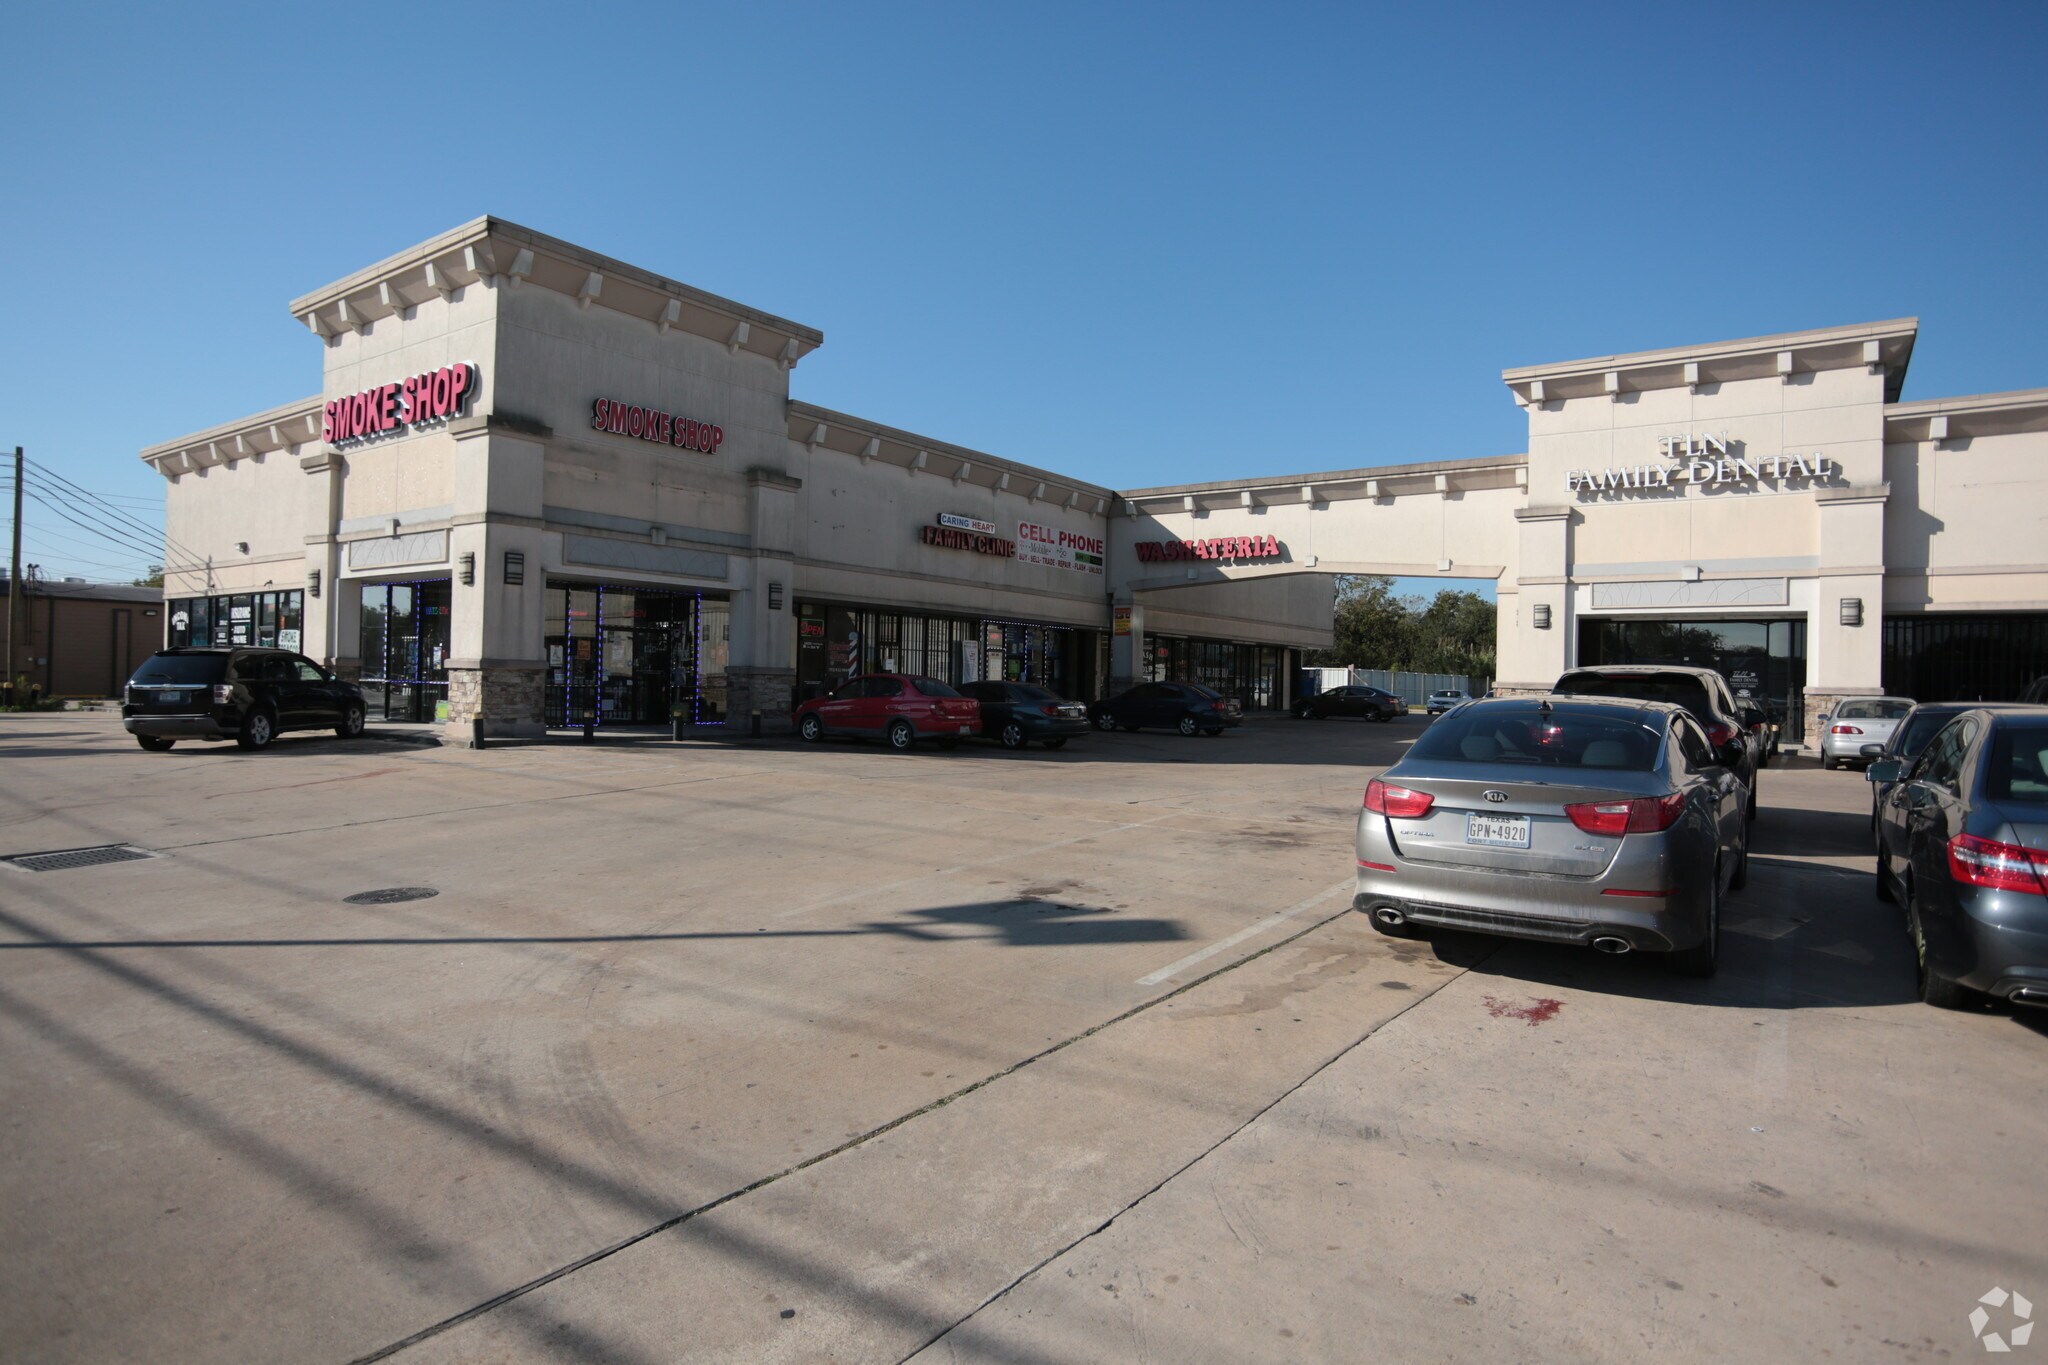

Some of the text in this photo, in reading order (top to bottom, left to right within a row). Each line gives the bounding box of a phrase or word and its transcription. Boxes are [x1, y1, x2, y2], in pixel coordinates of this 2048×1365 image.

[323, 363, 467, 444] SMOKE SHOP
[595, 397, 725, 455] SMOKE SHOP
[1657, 431, 1729, 458] TLN
[1564, 451, 1832, 493] FAMILY DENTAL
[941, 515, 995, 533] CARING HEART
[1019, 523, 1103, 554] CELL PHONE
[924, 526, 1016, 558] FAMILY CLINIC
[1134, 534, 1280, 563] WASHATERIA
[1030, 555, 1041, 564] SELL
[1042, 557, 1056, 566] TRADE
[1057, 559, 1071, 569] REPAIR
[1074, 563, 1086, 572] FLASH
[1486, 792, 1506, 802] KIA
[1487, 816, 1511, 824] TEXAS
